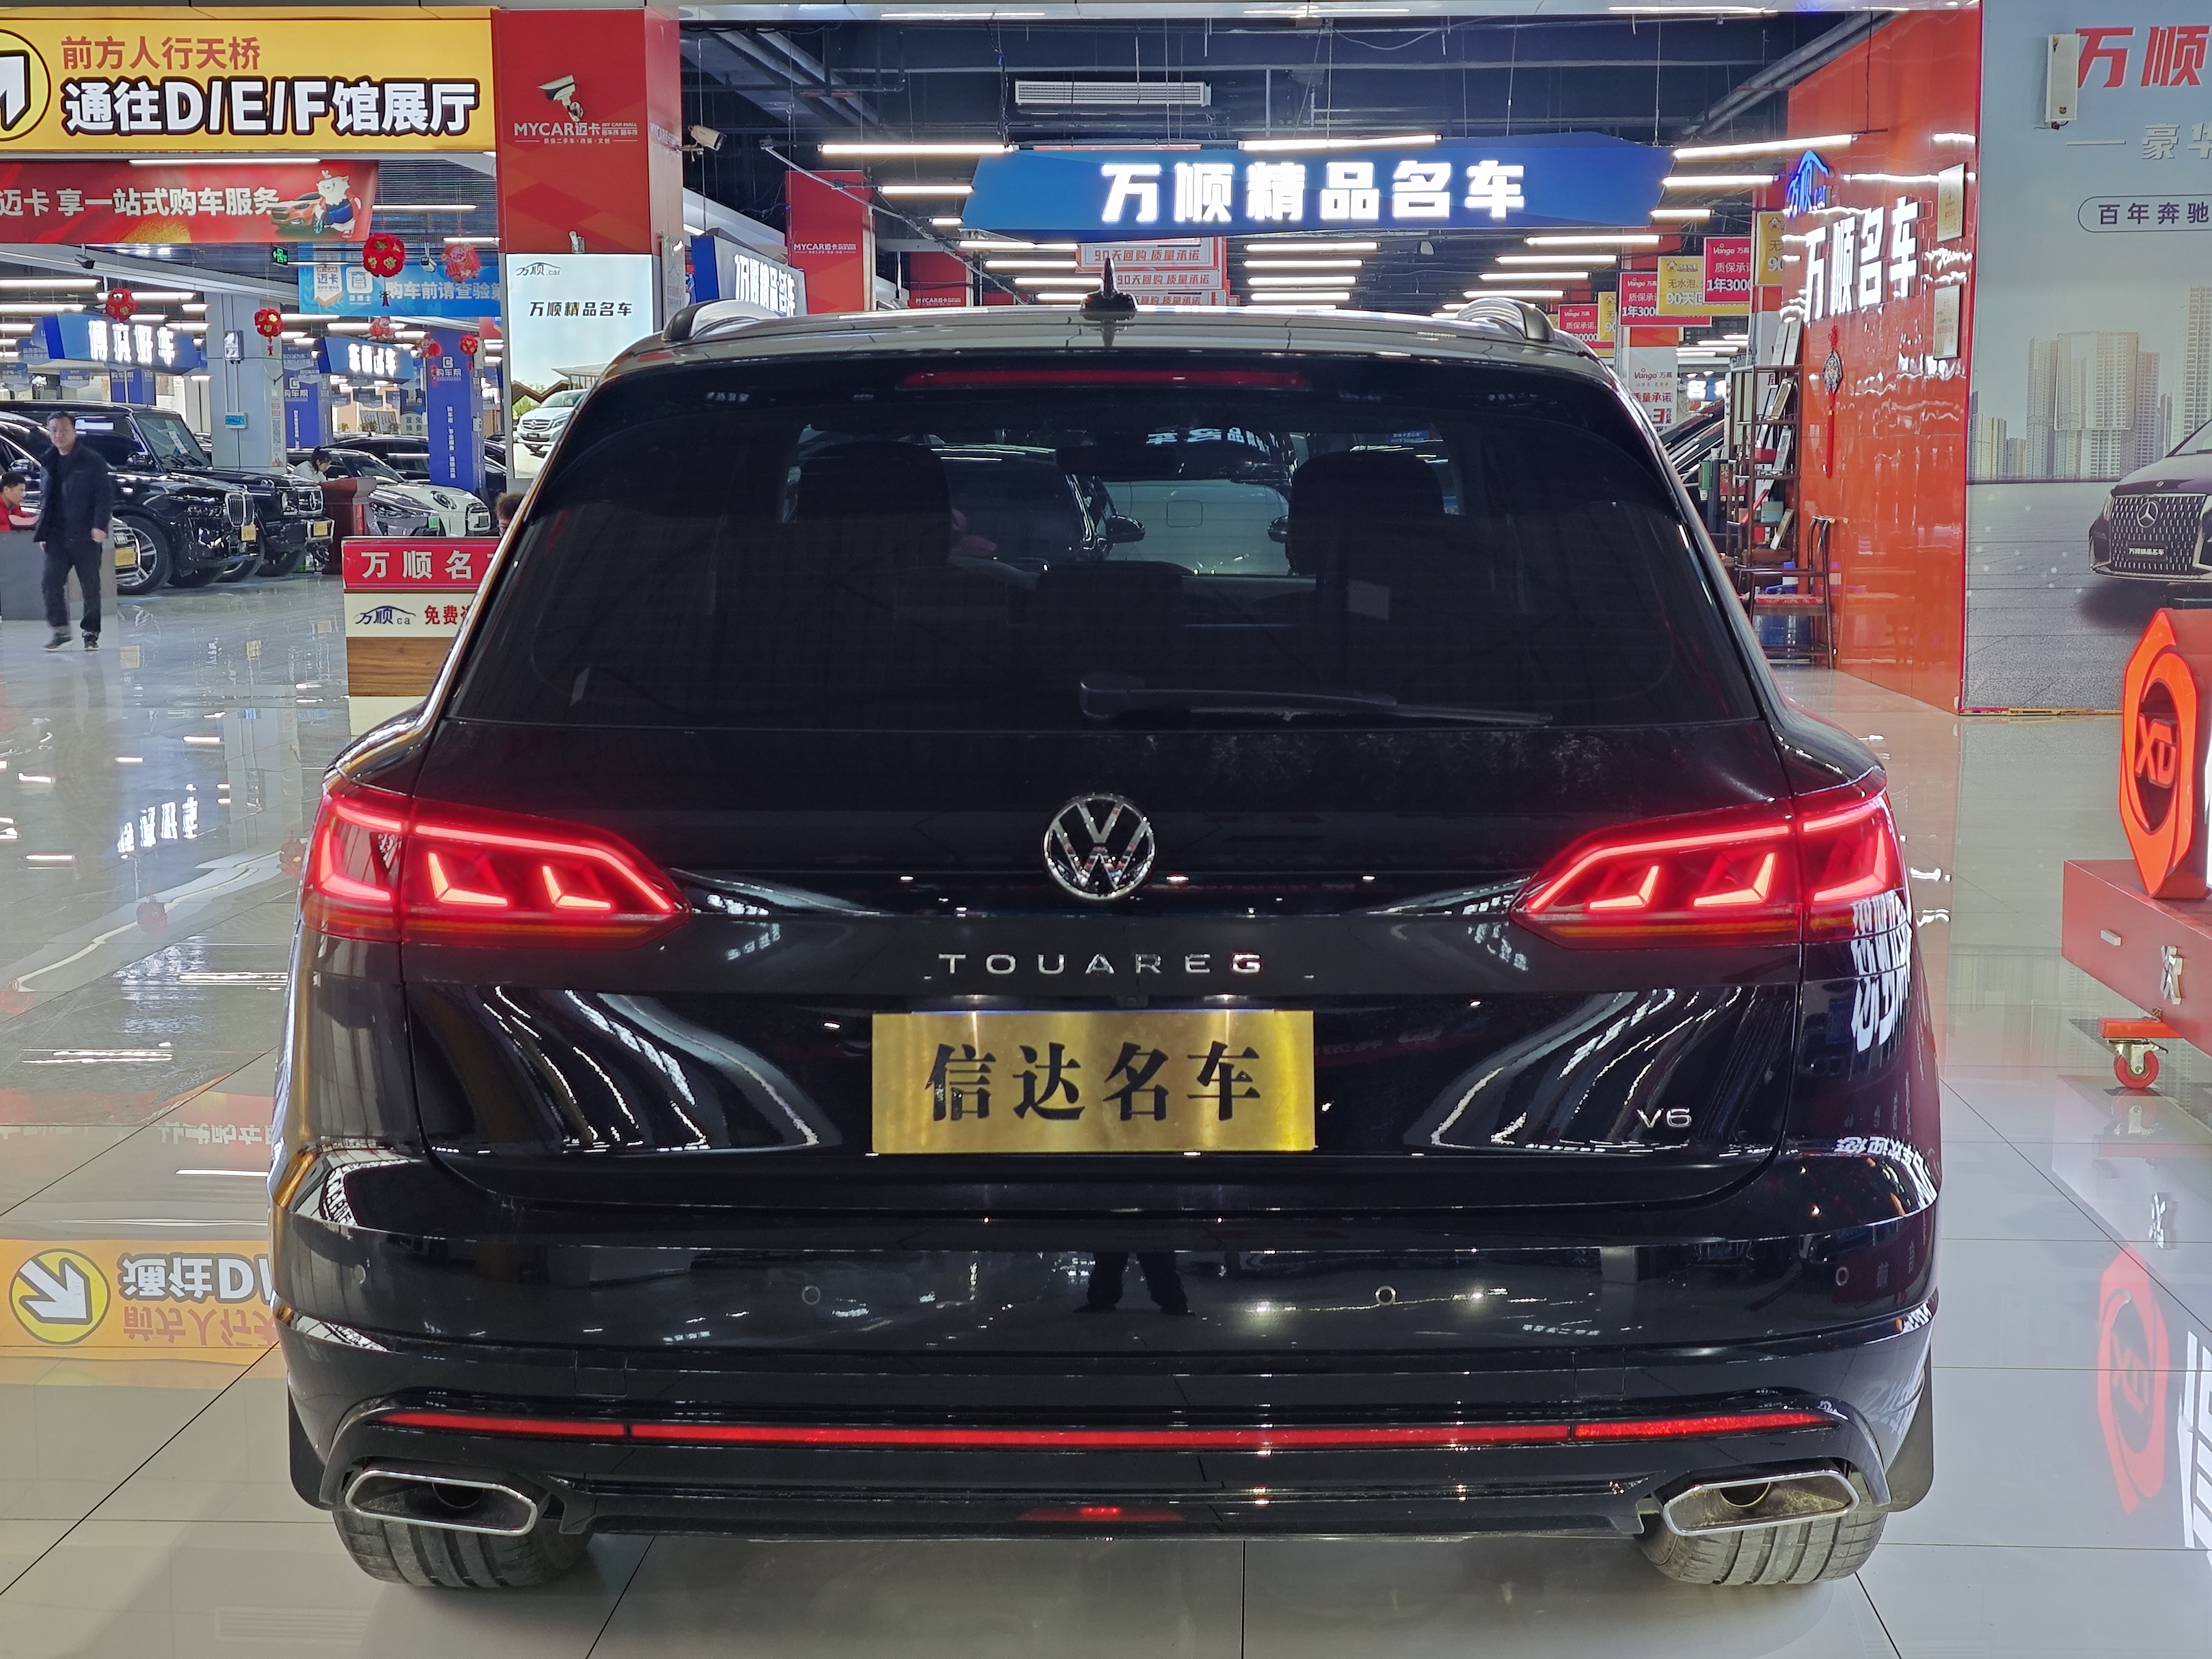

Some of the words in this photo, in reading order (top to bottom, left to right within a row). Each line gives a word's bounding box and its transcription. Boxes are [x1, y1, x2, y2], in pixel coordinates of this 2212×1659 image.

[62, 36, 261, 71] 前方人行天桥
[2075, 25, 2210, 87] 万顺
[63, 78, 478, 135] 通往D/E/F馆展厅
[0, 188, 50, 217] 迈卡
[57, 186, 280, 217] 享一站式购车服务
[1101, 160, 1526, 221] 万顺精品名车
[2098, 202, 2209, 225] 百年奔驰
[1151, 249, 1201, 261] 质量承诺
[1713, 243, 1735, 255] Vango
[1804, 196, 1919, 323] 万顺名车
[317, 273, 339, 284] 迈卡
[1117, 274, 1163, 285] 90天回购
[1167, 274, 1210, 285] 质量承诺
[529, 301, 632, 316] 万顺精品名车
[1163, 296, 1201, 305] 质量承诺
[1634, 368, 1657, 380] Vango
[361, 550, 495, 580] 万顺名
[938, 953, 1262, 974] TOUAREG
[925, 1041, 1262, 1123] 信达名车
[1637, 1107, 1692, 1129] V6
